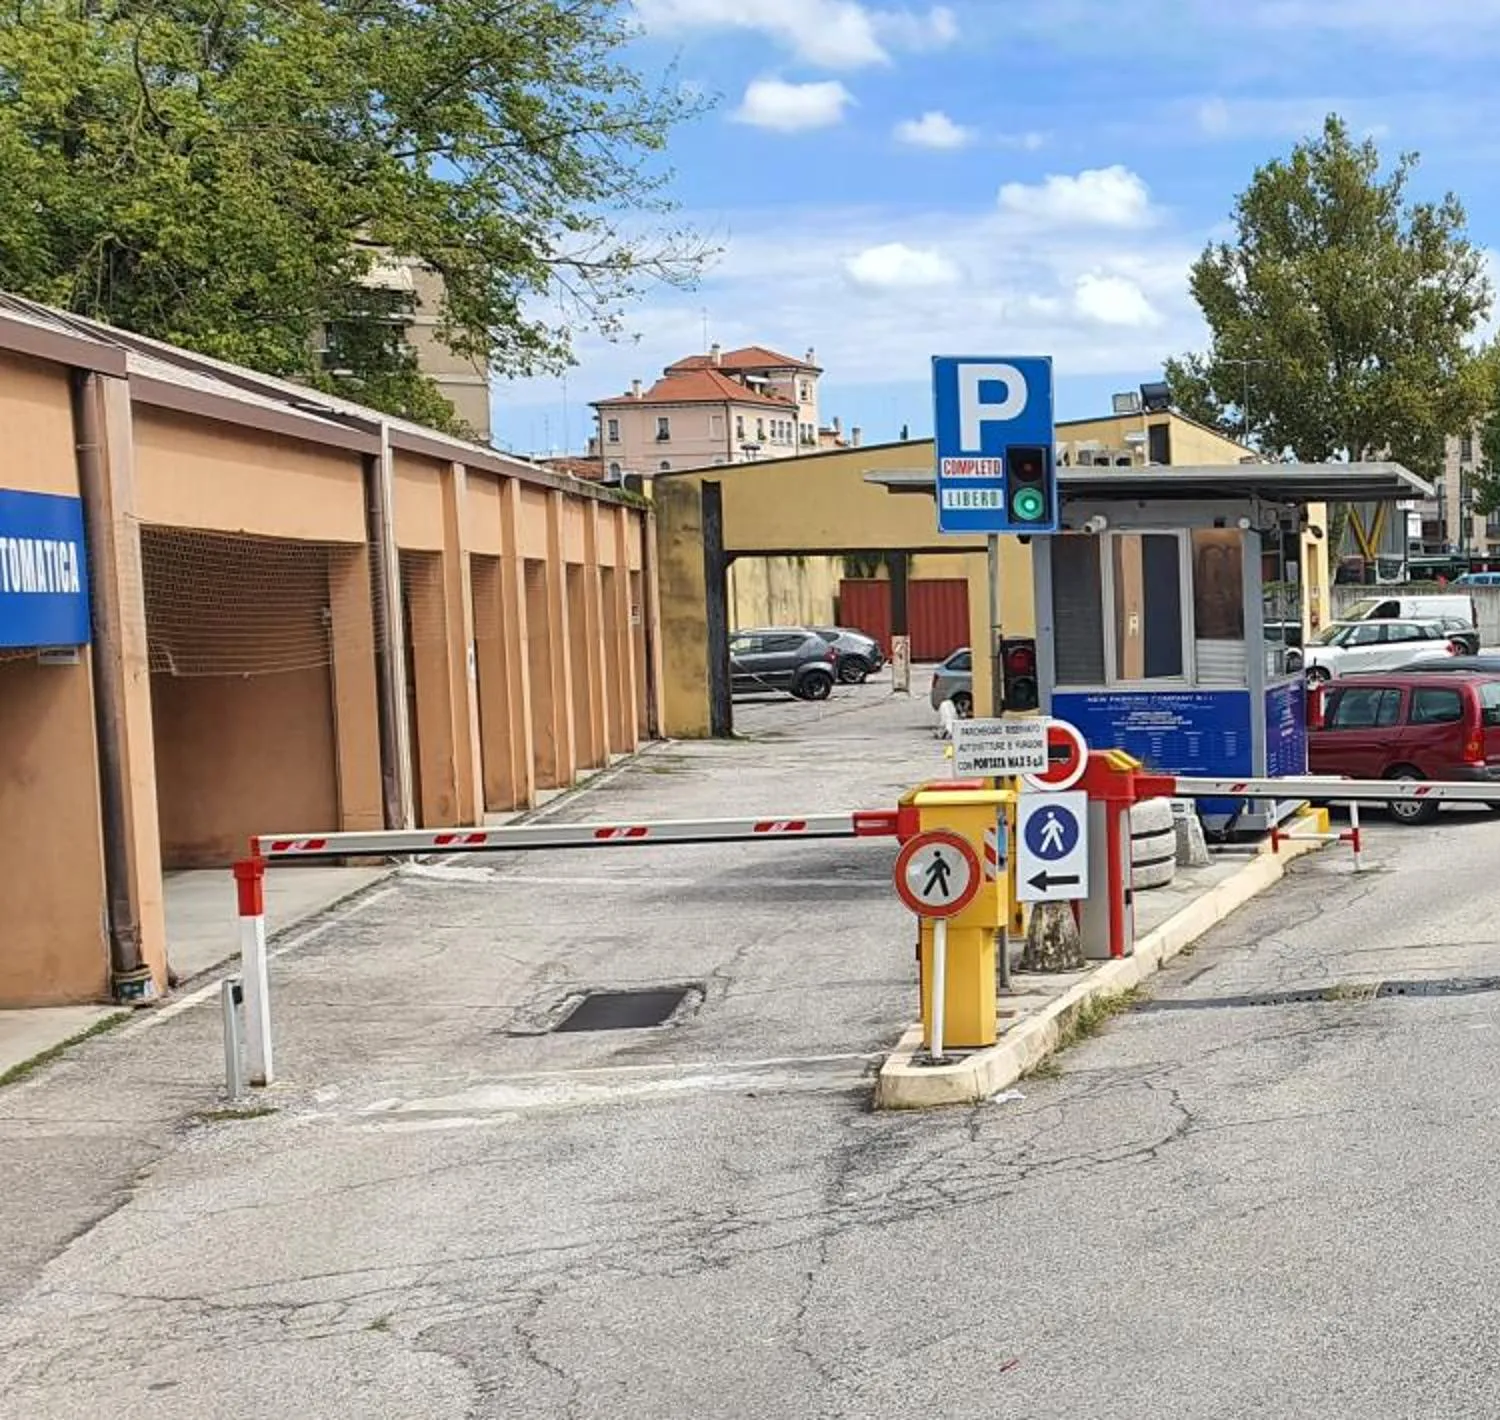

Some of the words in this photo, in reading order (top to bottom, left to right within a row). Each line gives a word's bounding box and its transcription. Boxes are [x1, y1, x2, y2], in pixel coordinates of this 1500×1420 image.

[957, 363, 1029, 452] P
[943, 459, 1000, 475] COMPLETO
[948, 490, 999, 506] LIBERO
[957, 761, 973, 771] CON
[973, 757, 1006, 769] PORTATA
[1007, 756, 1025, 768] MAX
